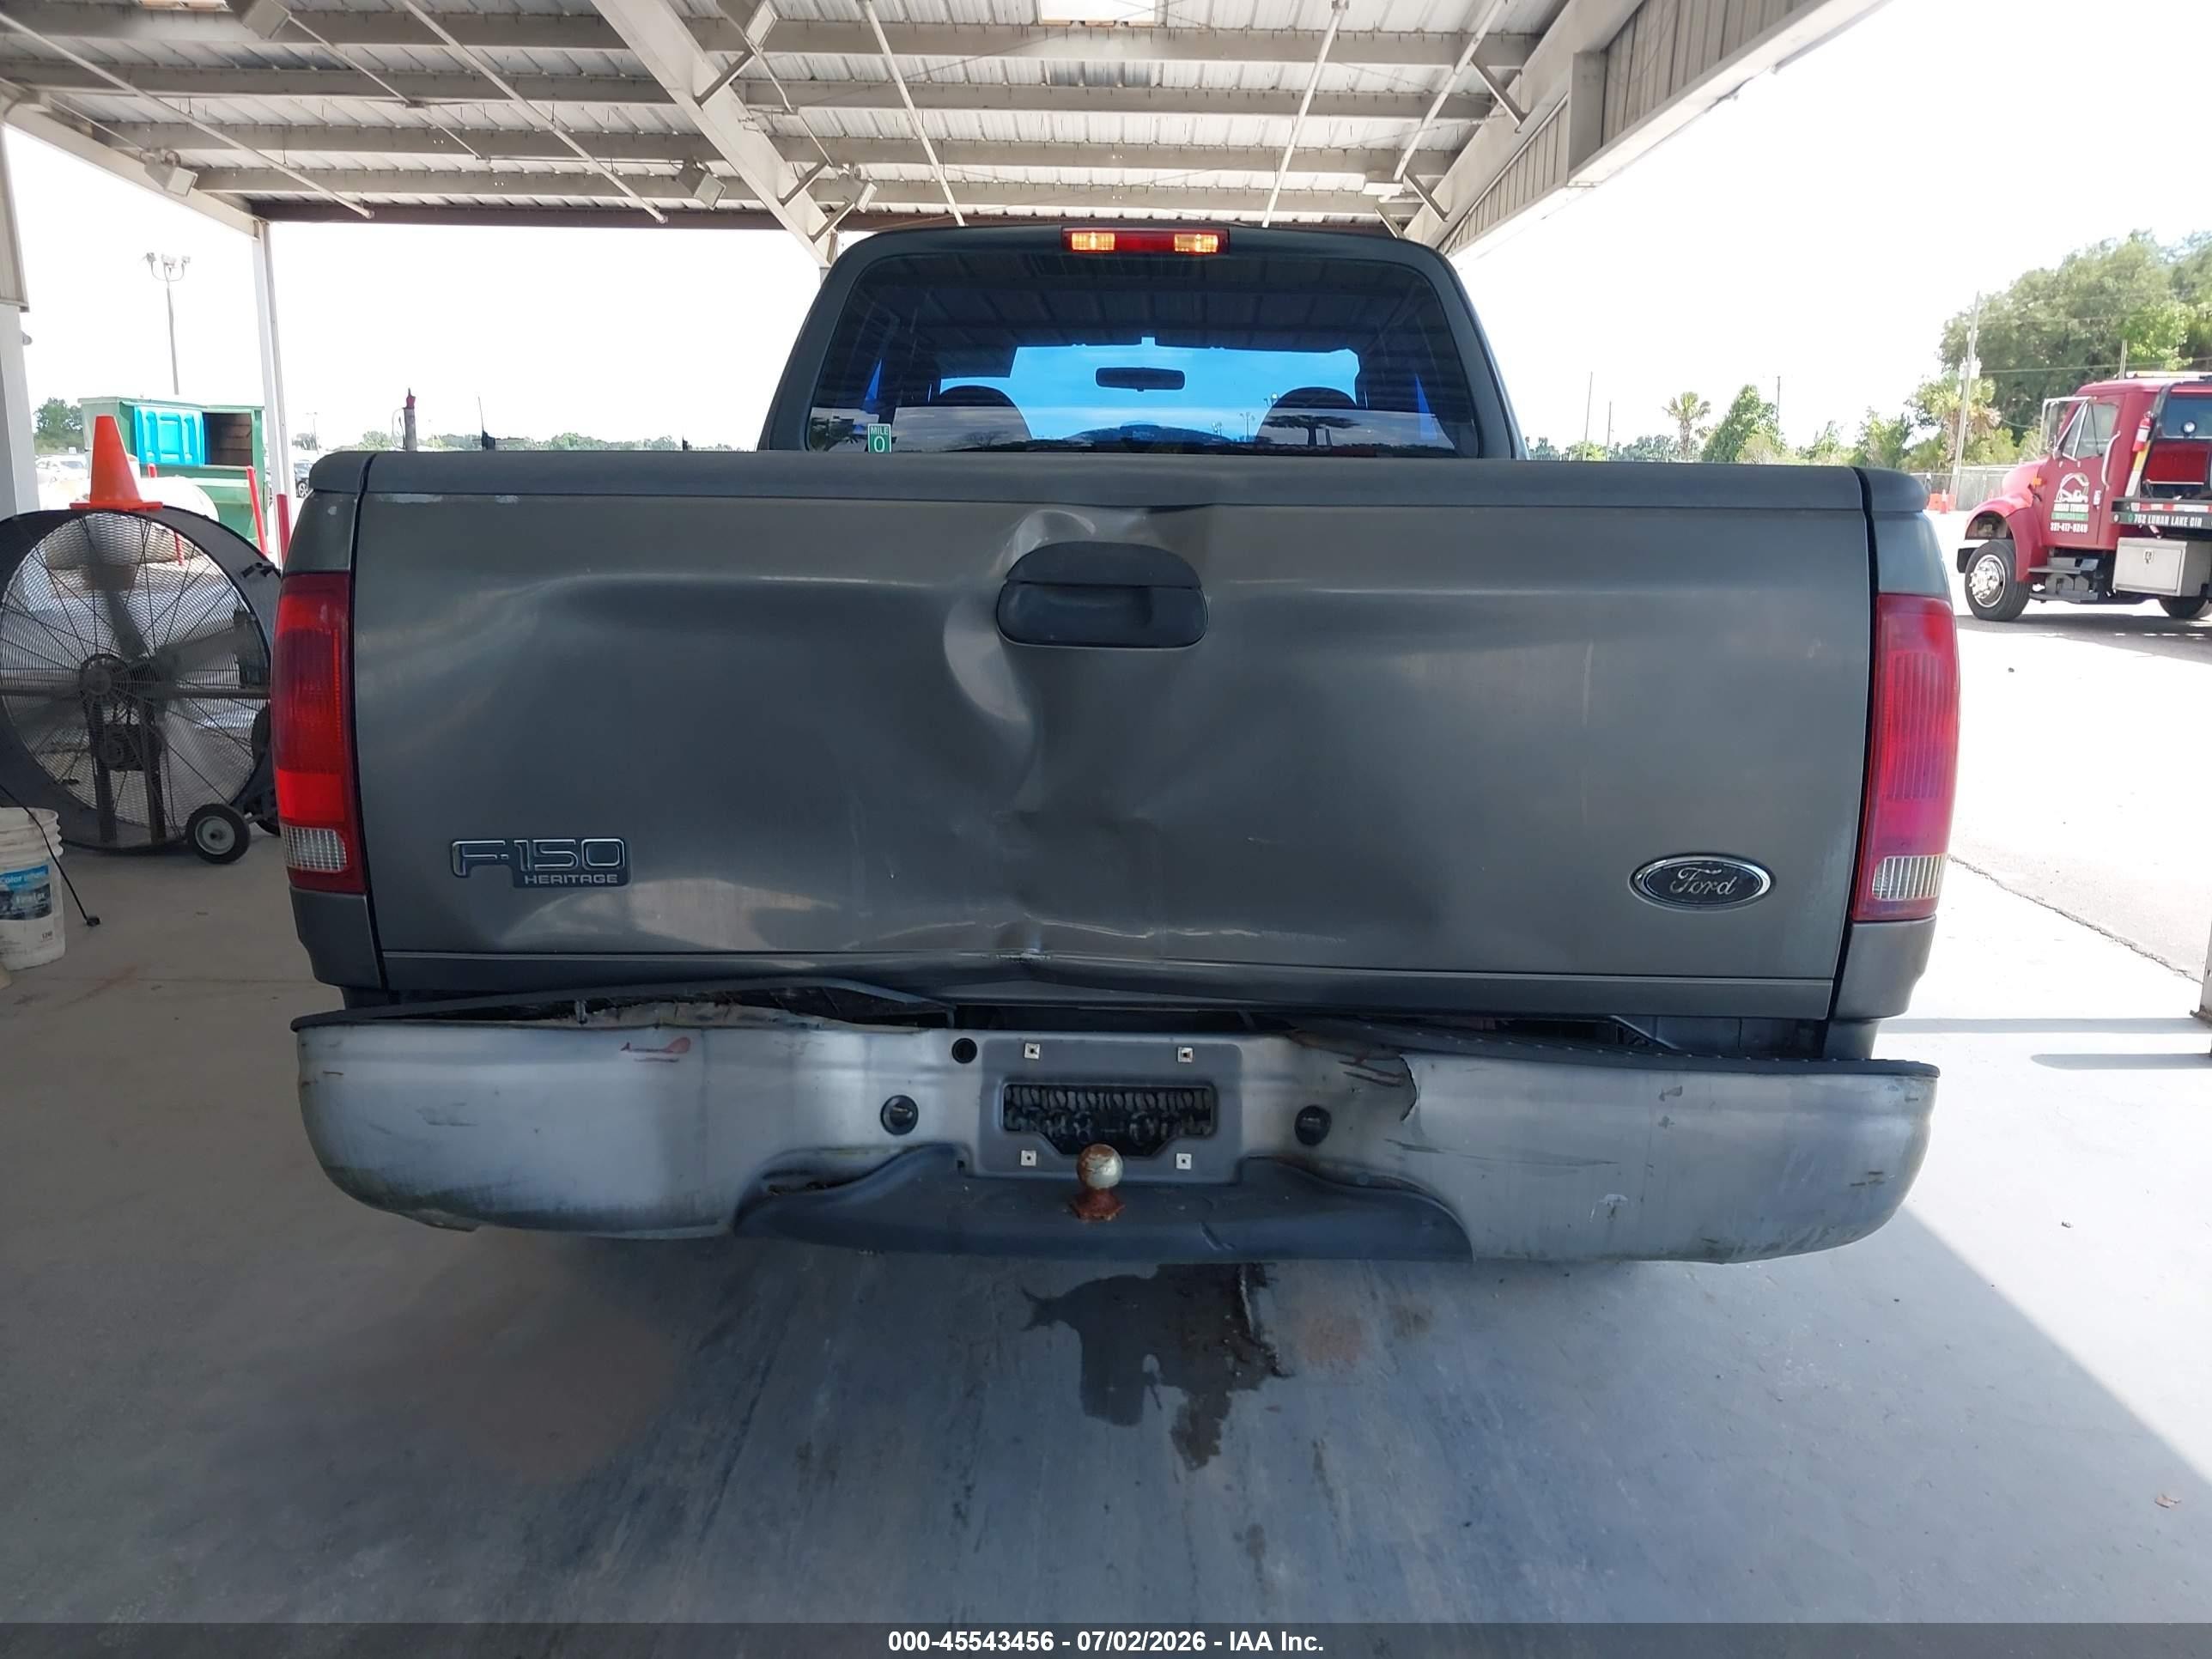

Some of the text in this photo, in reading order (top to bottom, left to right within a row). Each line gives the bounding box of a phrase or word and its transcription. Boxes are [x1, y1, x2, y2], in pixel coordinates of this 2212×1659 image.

[871, 426, 889, 435] MILE
[2148, 514, 2170, 526] LUNAR
[2171, 515, 2188, 527] LAKE
[451, 837, 625, 878] F-150
[525, 873, 618, 884] HERITAGE
[1669, 866, 1738, 896] Ford
